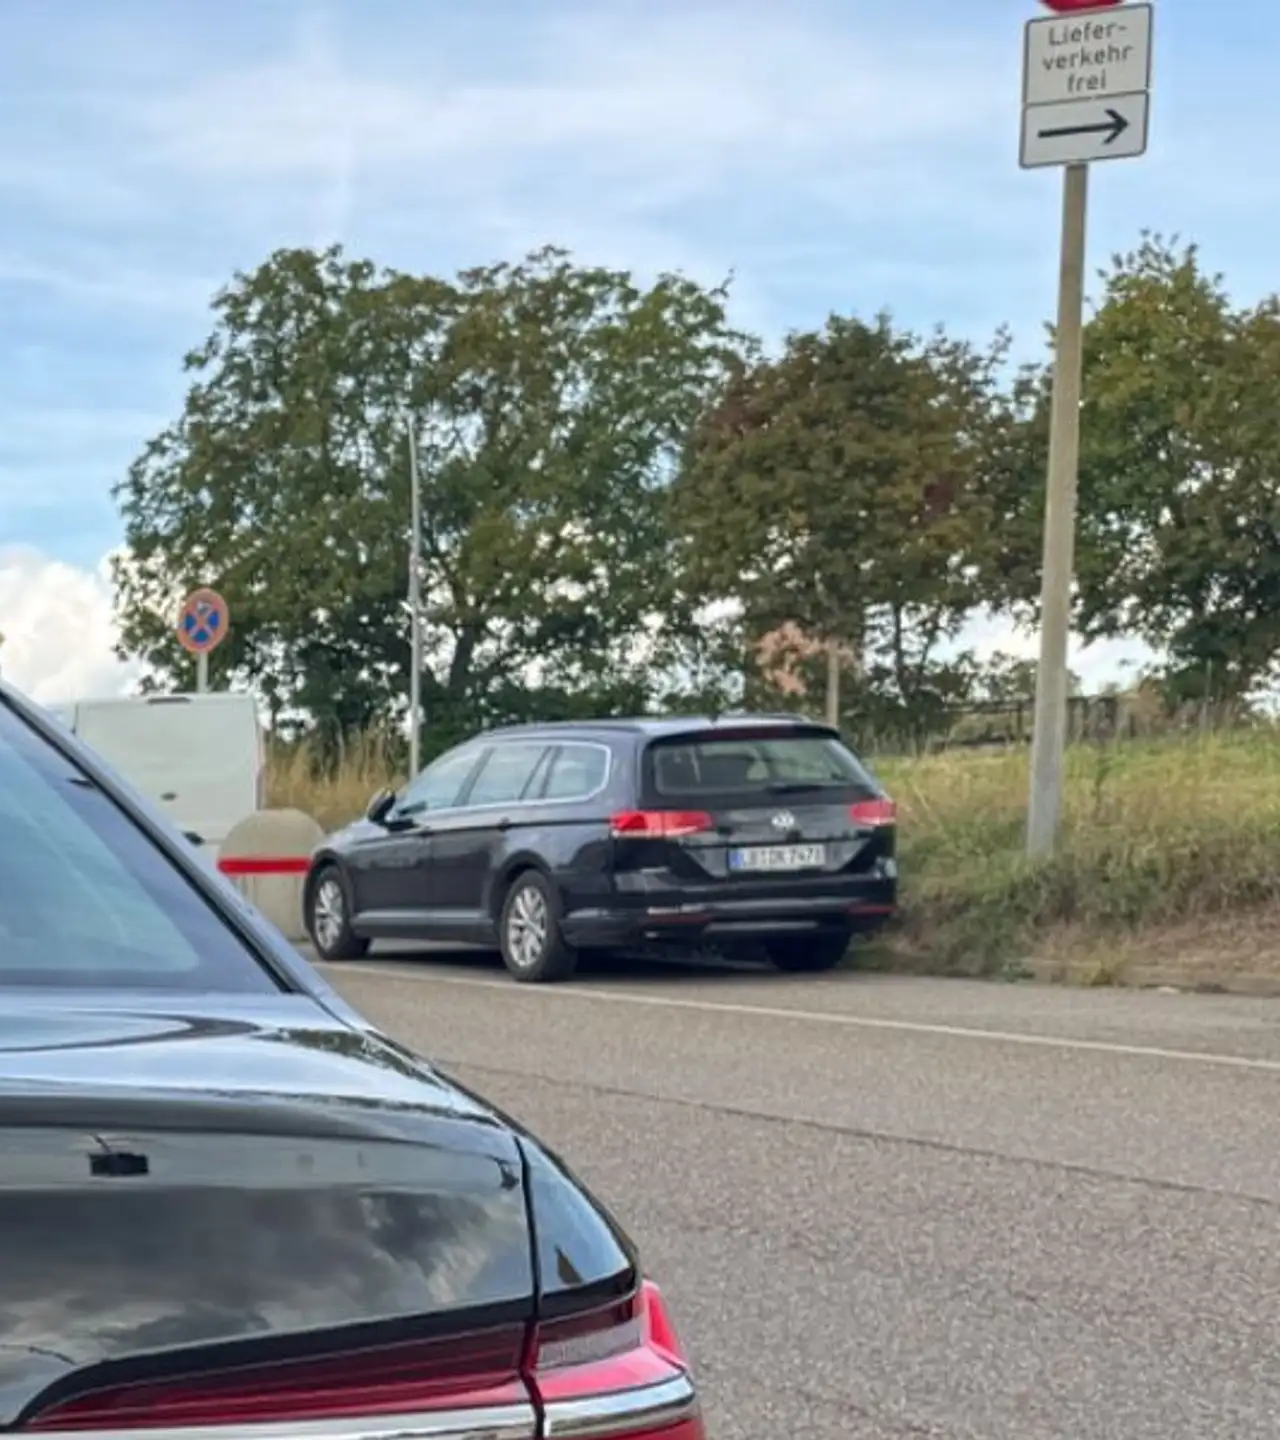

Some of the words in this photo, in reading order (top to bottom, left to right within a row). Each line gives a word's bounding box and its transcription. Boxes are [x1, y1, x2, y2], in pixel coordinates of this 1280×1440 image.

[1048, 22, 1128, 46] Liefer-
[1042, 44, 1135, 71] verkehr
[1067, 67, 1107, 92] frei
